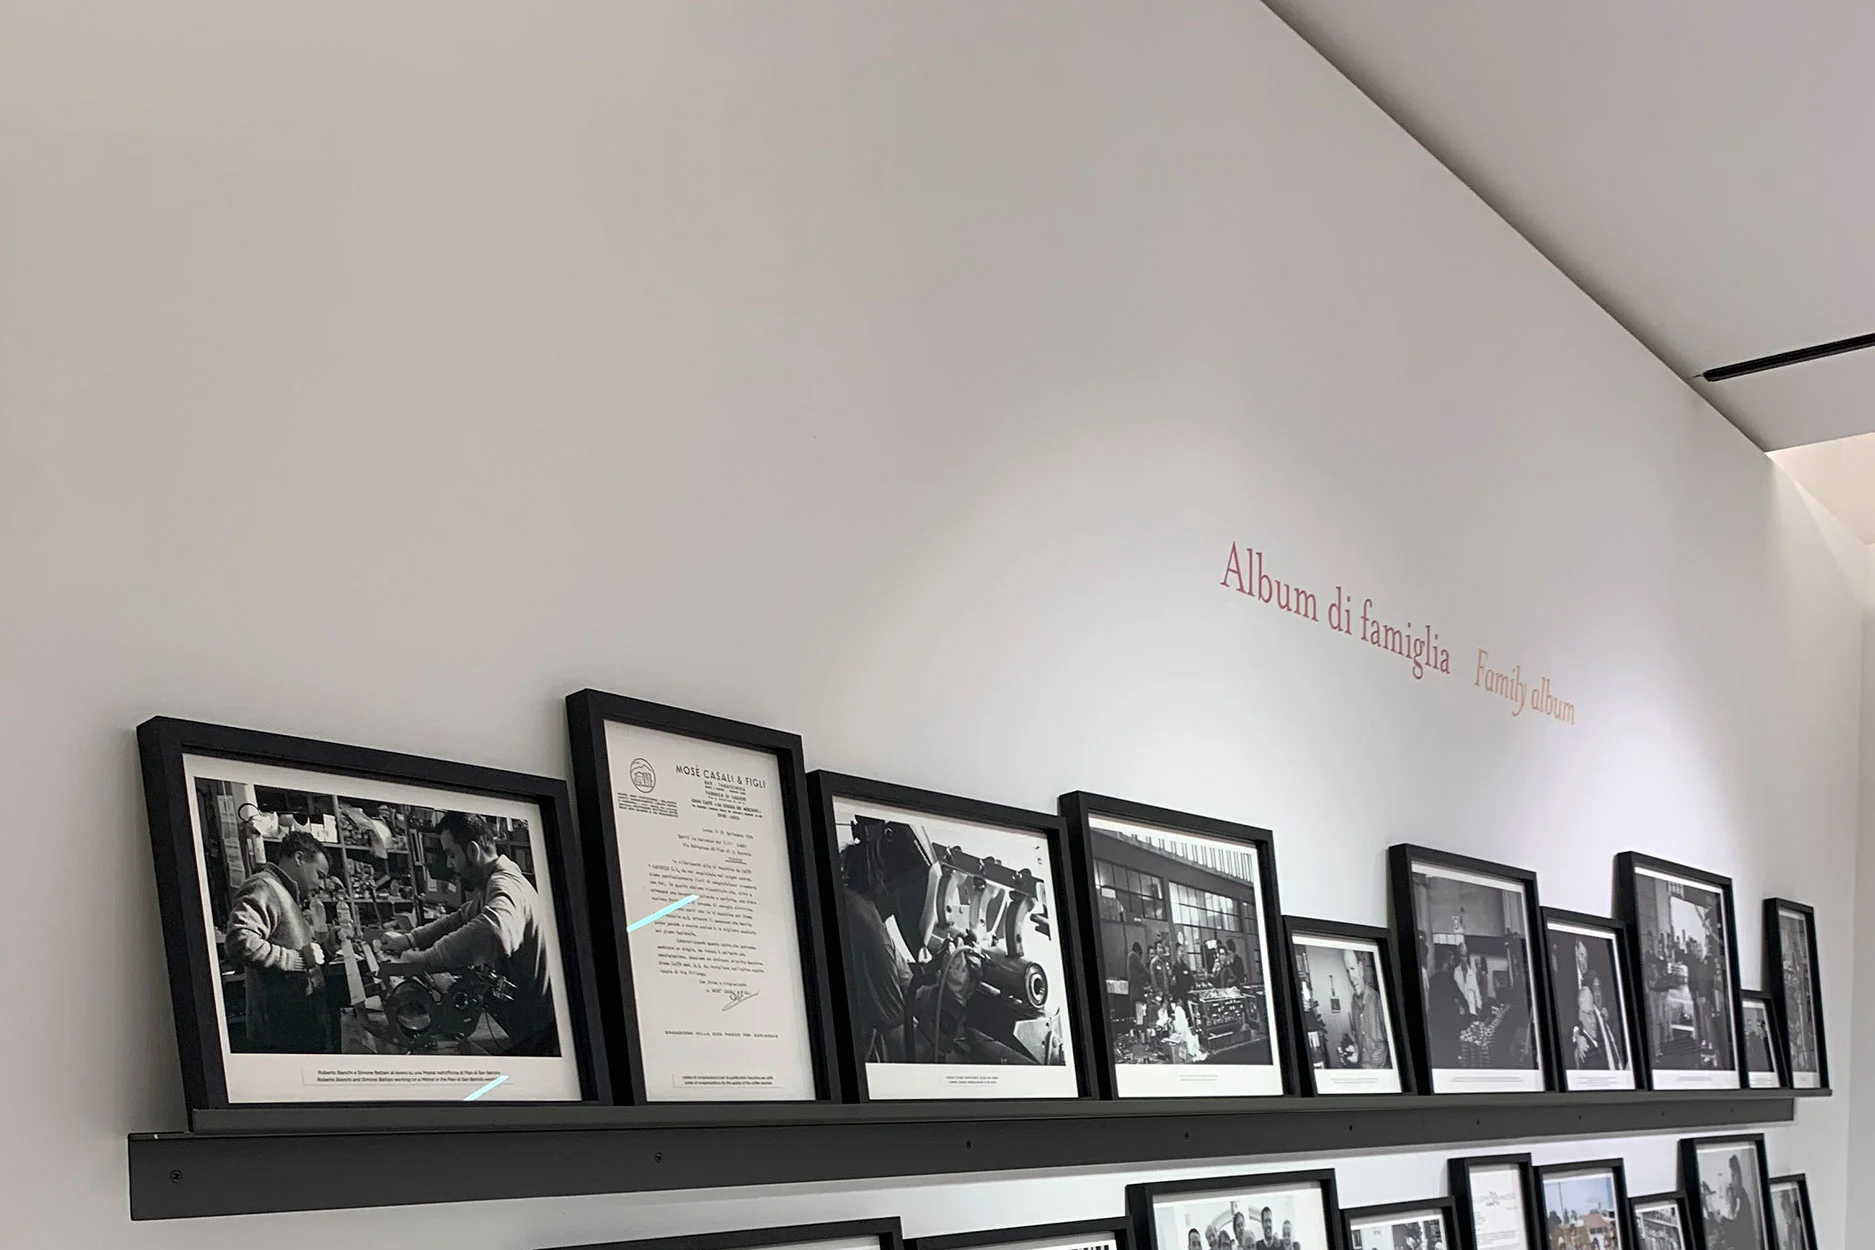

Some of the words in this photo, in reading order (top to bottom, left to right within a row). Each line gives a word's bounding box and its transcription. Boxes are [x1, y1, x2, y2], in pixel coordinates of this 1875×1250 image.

[1220, 541, 1319, 622] Album
[1328, 586, 1352, 635] di
[1360, 599, 1451, 680] famiglia
[1474, 648, 1527, 716] Family
[1531, 676, 1575, 725] album
[703, 769, 735, 783] CASALI
[736, 776, 743, 785] &
[745, 776, 766, 788] FIGLI
